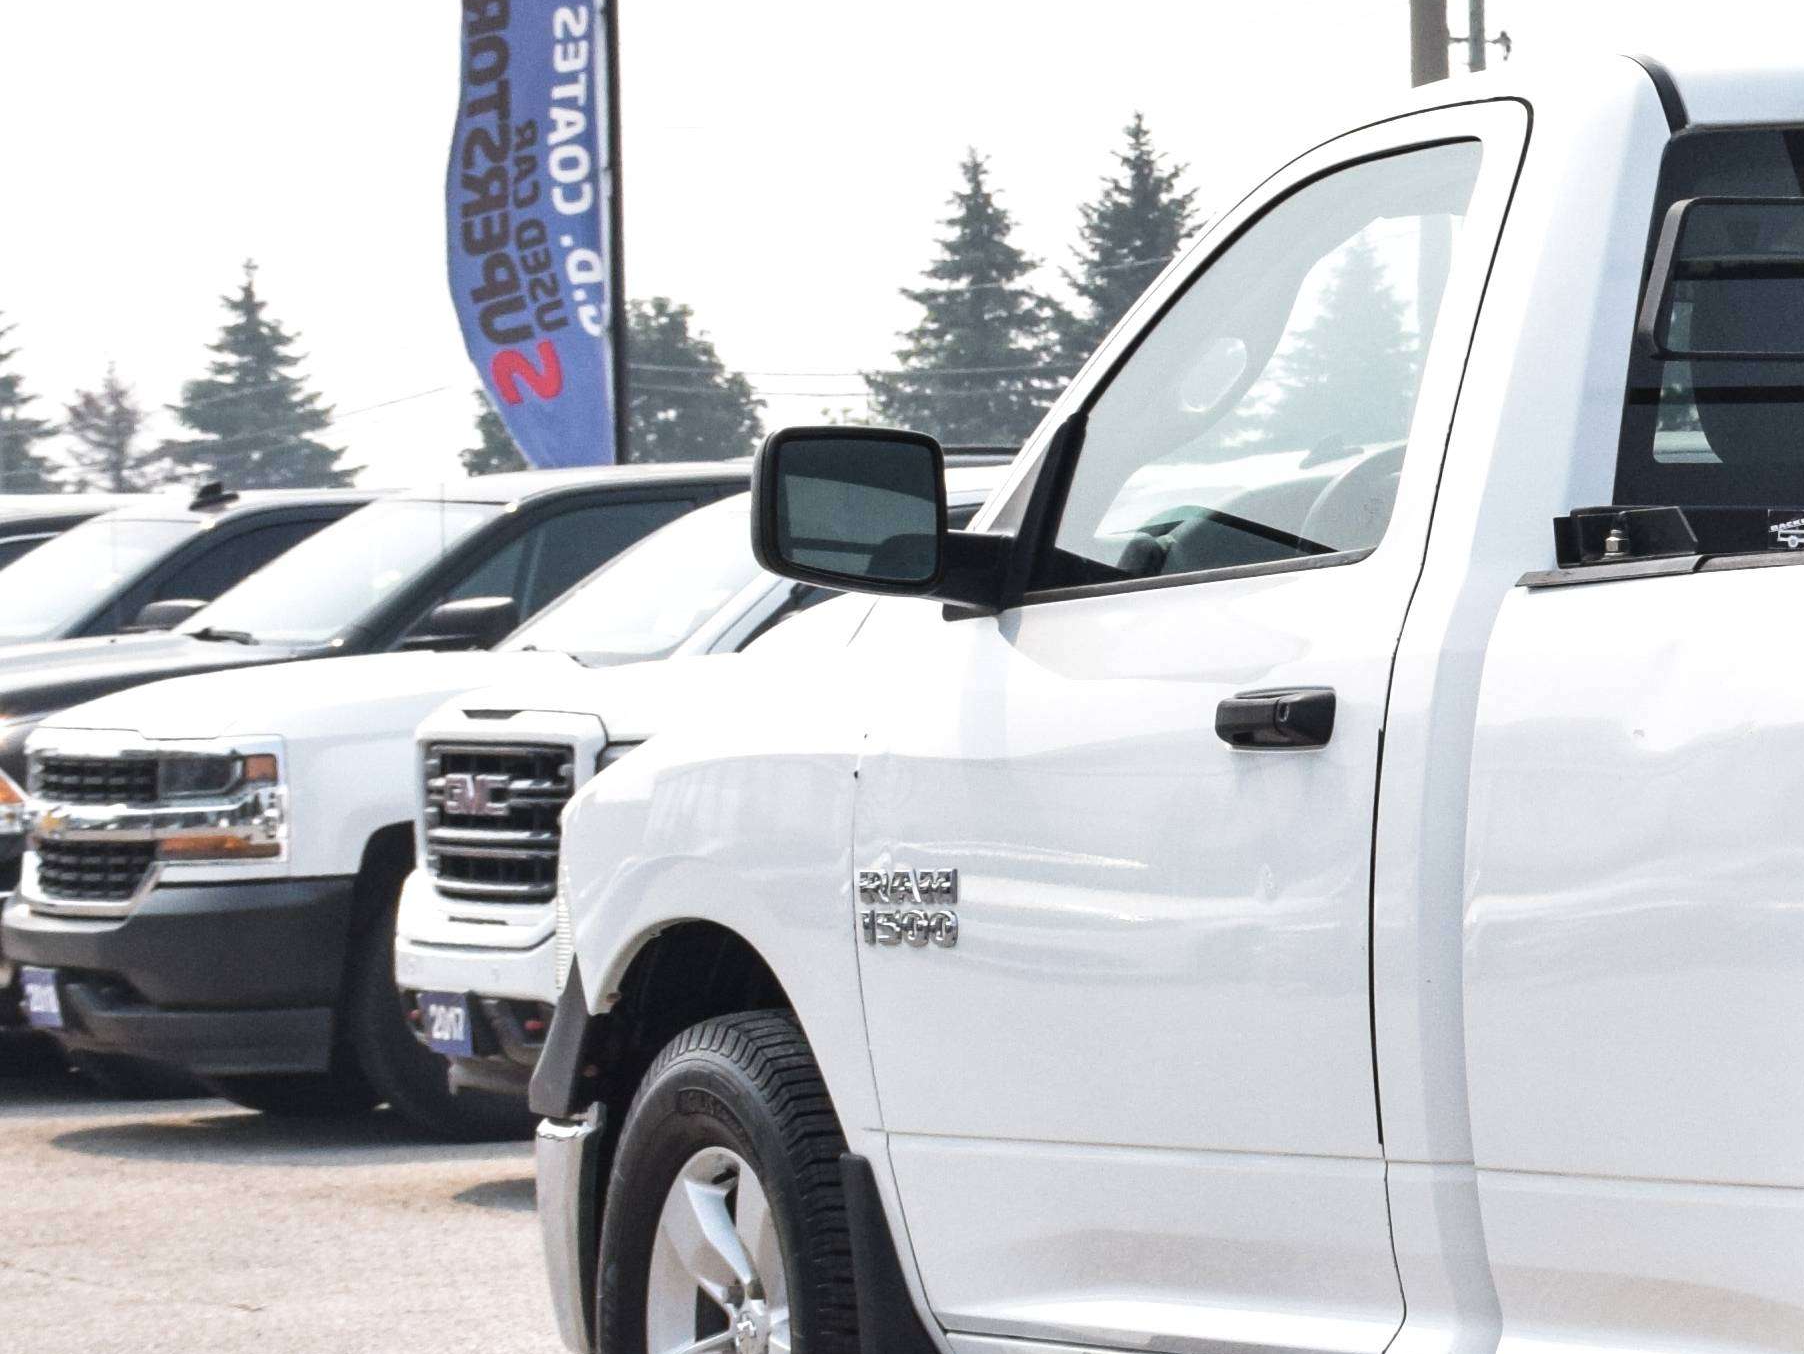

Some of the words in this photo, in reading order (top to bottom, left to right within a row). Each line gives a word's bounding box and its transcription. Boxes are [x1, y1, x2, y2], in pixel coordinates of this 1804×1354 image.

[445, 773, 510, 816] GMC
[858, 868, 958, 905] RAM
[860, 909, 959, 948] 1500
